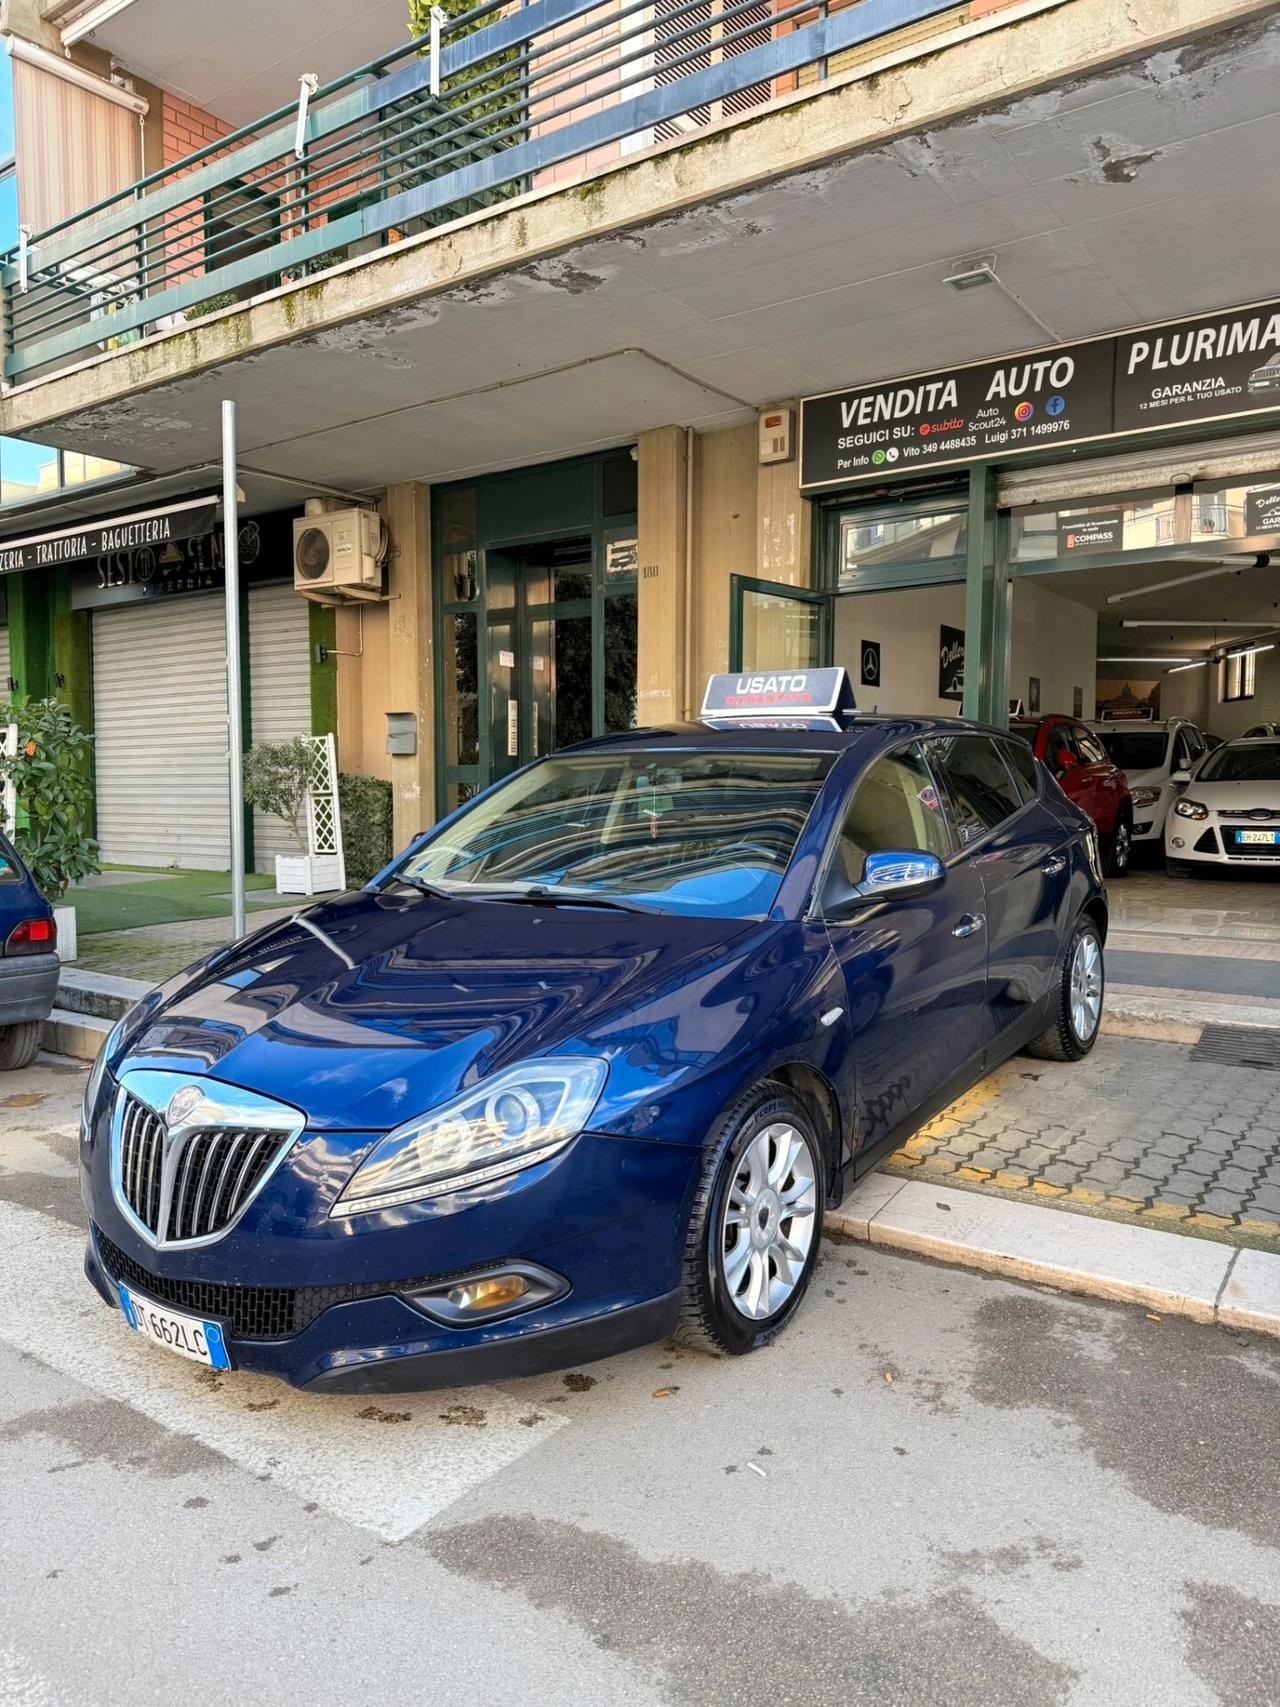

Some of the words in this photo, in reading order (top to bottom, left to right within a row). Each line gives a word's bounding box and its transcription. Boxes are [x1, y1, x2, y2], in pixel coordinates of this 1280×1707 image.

[841, 379, 958, 428] VENDITA
[985, 356, 1075, 401] AUTO
[1149, 399, 1168, 408] MESI
[1169, 397, 1186, 406] PER
[1196, 392, 1213, 400] TUO
[1215, 386, 1242, 397] USATO
[1151, 376, 1225, 399] GARANZIA
[968, 417, 1007, 432] Scout24
[976, 407, 999, 419] Auto
[837, 458, 852, 470] Per
[853, 456, 869, 468] Info
[903, 446, 920, 458] Vito
[922, 442, 938, 455] 349
[939, 436, 977, 451] 4488435
[985, 429, 1009, 445] Luigi
[1011, 428, 1027, 440] 371
[1030, 419, 1070, 436] 1499976
[838, 430, 890, 449] SEGUICI
[893, 425, 915, 439] SU:
[930, 417, 965, 433] subito
[36, 540, 87, 564] TRATTORIA
[102, 518, 171, 551] BAGUETTERIA
[1075, 532, 1114, 543] COMPASS
[735, 675, 808, 694] USATO
[150, 1313, 208, 1356] 662LC
